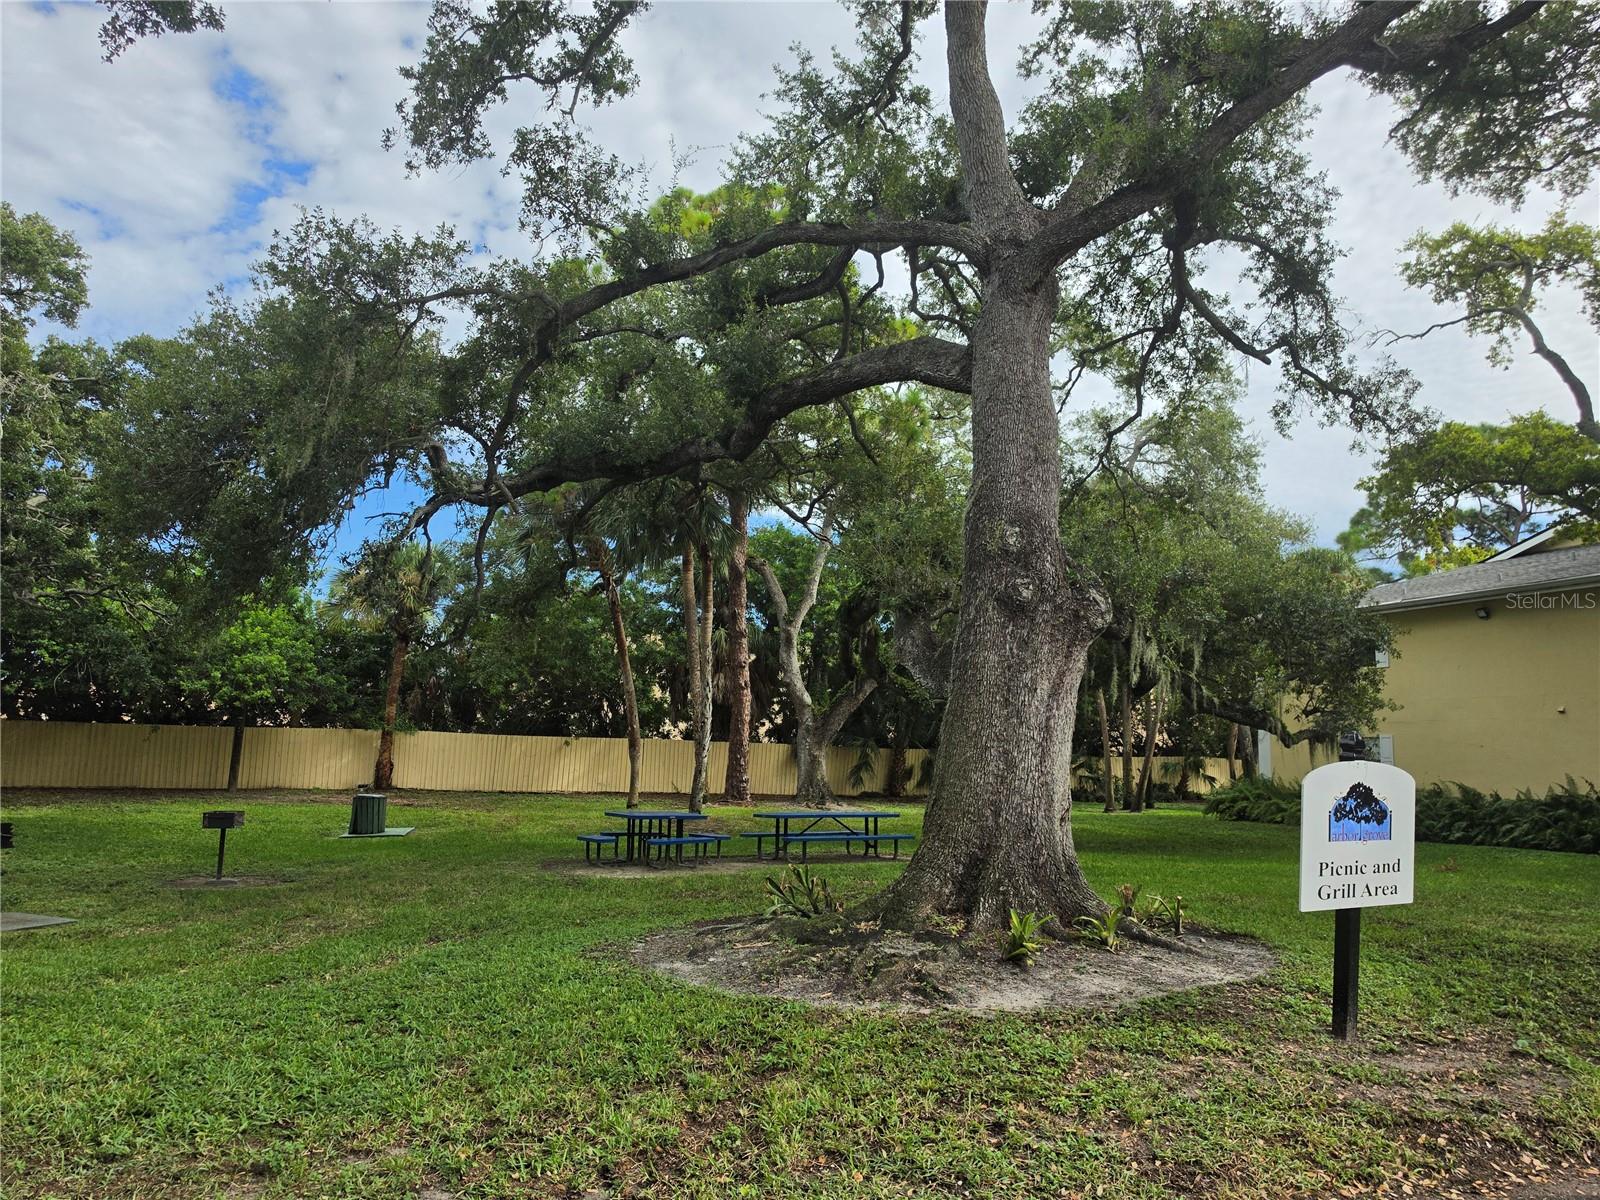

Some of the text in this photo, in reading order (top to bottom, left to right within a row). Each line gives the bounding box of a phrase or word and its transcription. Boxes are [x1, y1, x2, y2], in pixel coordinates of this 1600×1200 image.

[1319, 858, 1401, 877] Picnic and
[1317, 883, 1398, 901] Grill Area
